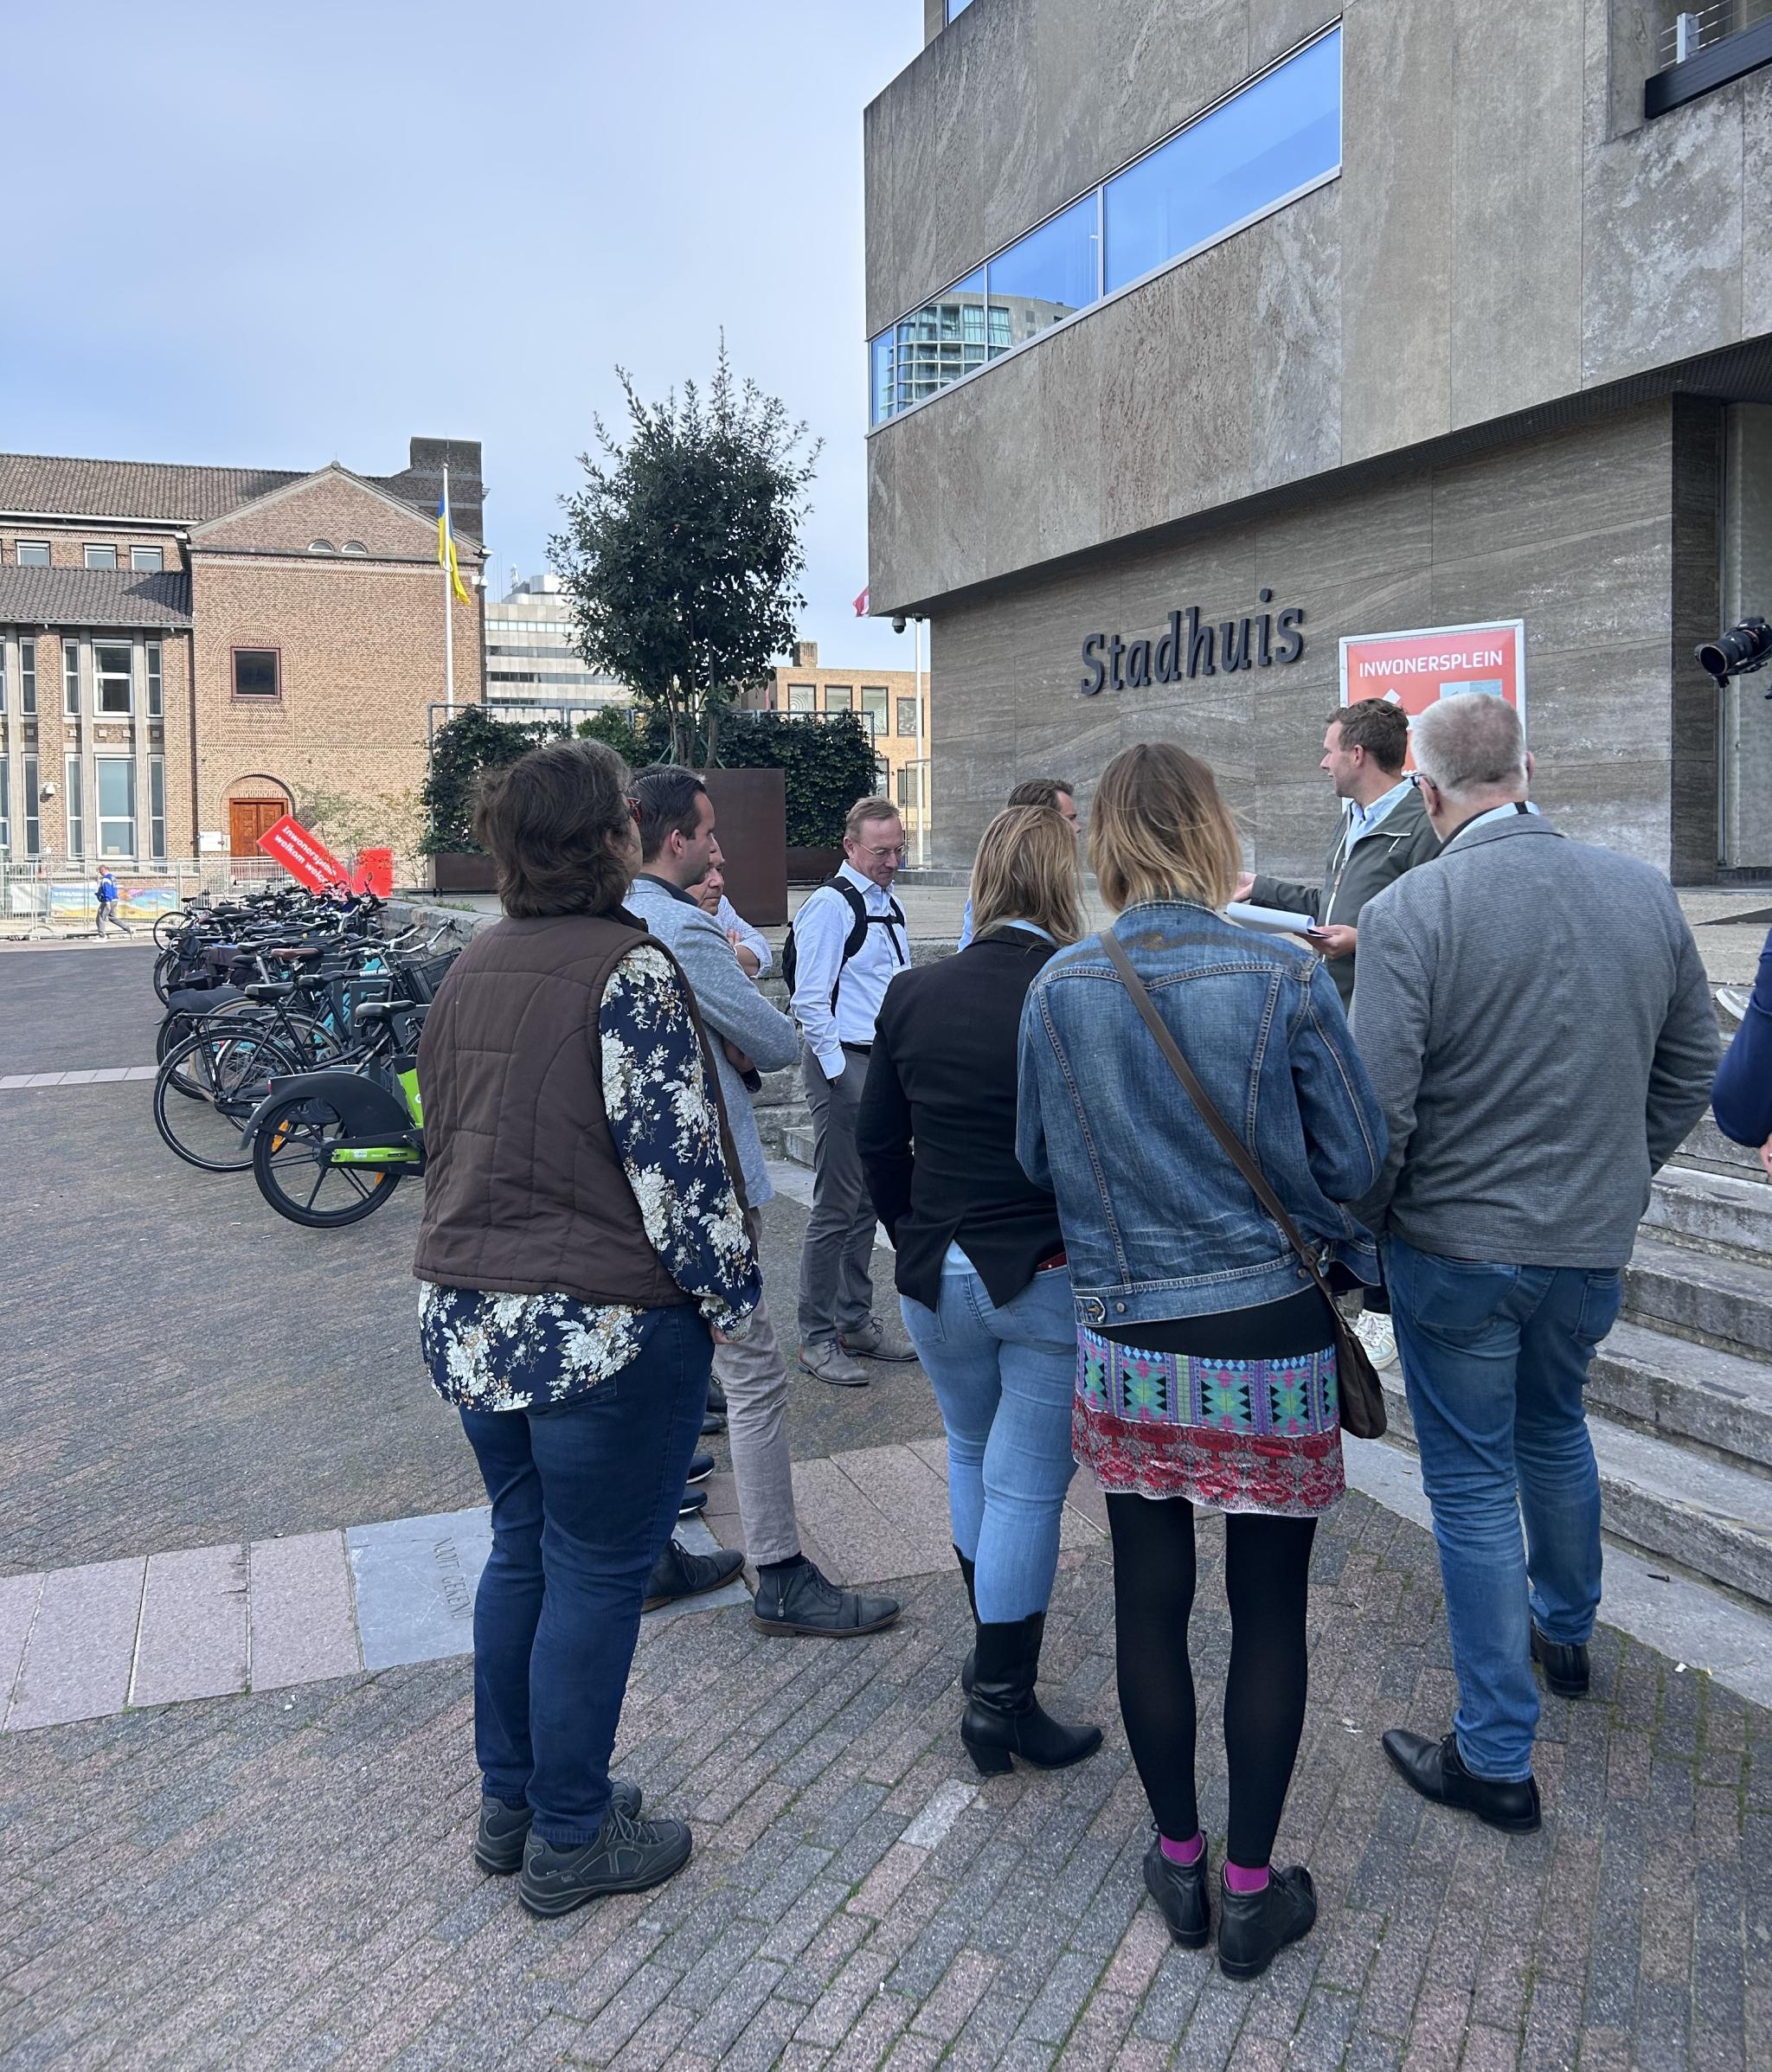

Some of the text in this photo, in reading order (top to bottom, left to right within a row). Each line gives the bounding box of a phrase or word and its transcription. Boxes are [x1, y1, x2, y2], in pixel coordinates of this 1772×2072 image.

[1081, 588, 1303, 695] Stadhuis
[1359, 650, 1503, 678] INWONERSPLEIN
[274, 834, 305, 864] welkom
[433, 1536, 473, 1620] NOOIT GEKEND
